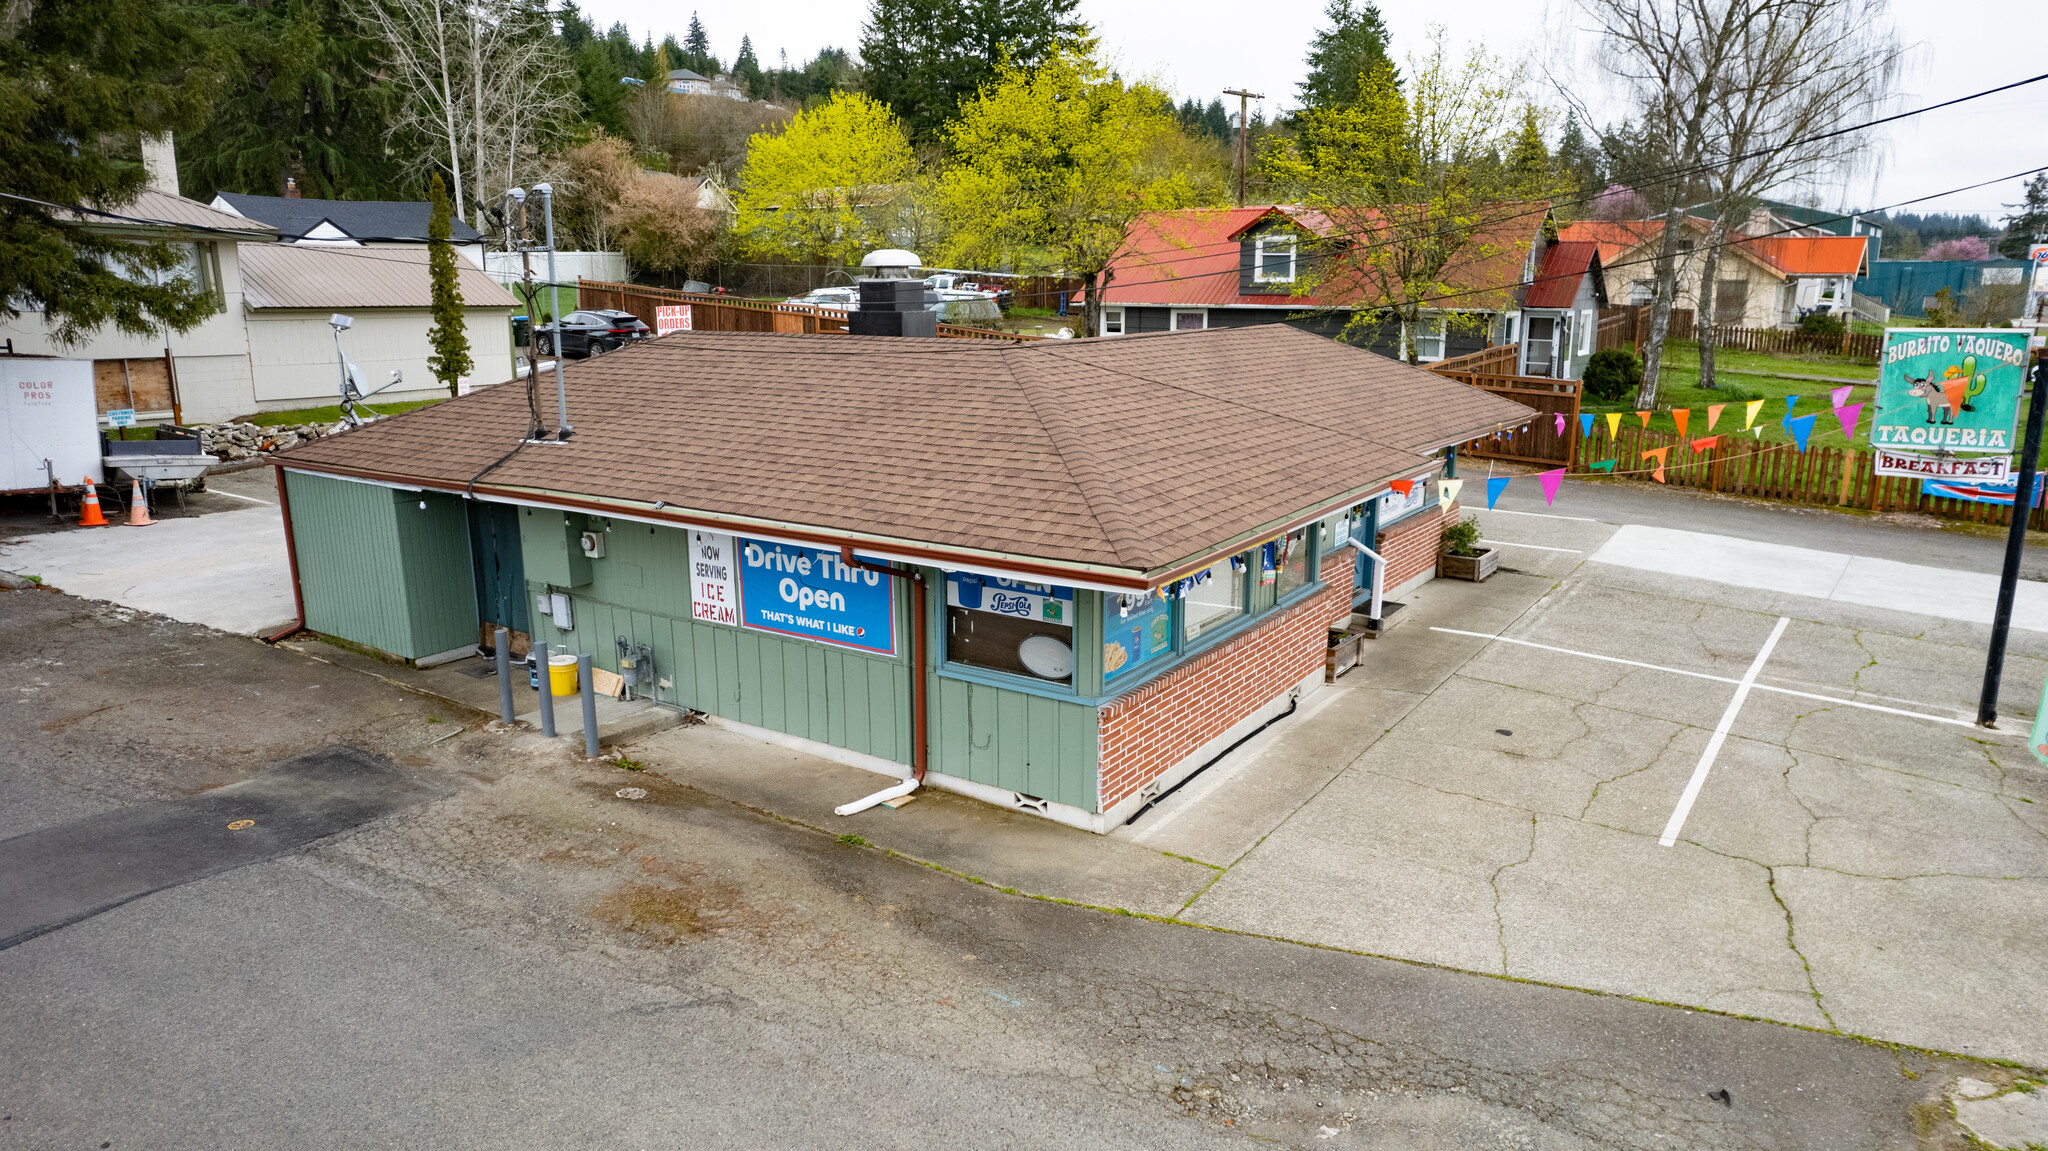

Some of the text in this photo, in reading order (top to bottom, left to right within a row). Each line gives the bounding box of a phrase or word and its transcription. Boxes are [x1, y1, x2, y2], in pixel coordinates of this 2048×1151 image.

[657, 306, 690, 317] PICK-UP
[658, 317, 690, 329] ORDERS
[1888, 334, 2023, 366] BURRITO VAQUERO
[19, 381, 53, 389] COLOR
[23, 391, 51, 399] PROS
[1881, 455, 2004, 477] BREAKFAST
[701, 545, 720, 562] NOW
[696, 562, 727, 581] SERVING
[747, 543, 880, 587] Drive Thru
[701, 582, 724, 602] ICE
[779, 577, 845, 612] Open
[693, 601, 735, 625] CREAM
[760, 609, 855, 636] THAT'S WHAT I LIKE
